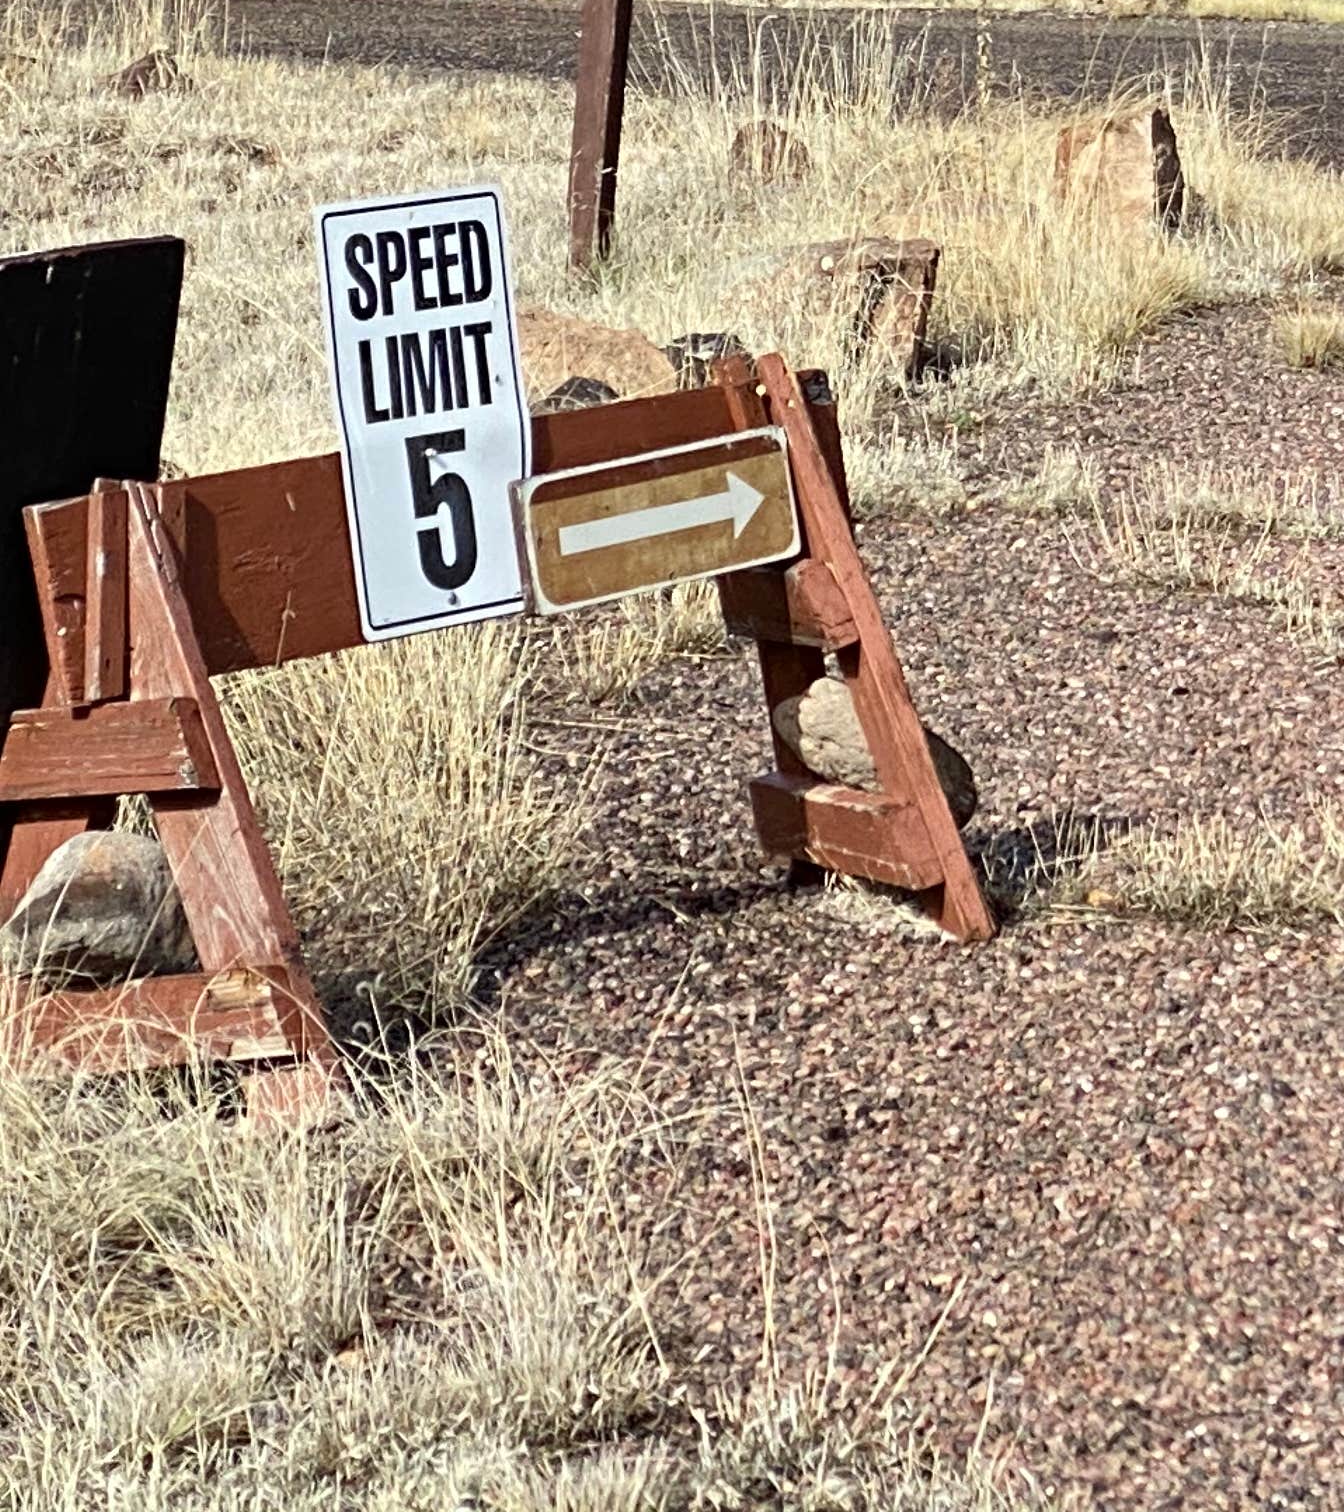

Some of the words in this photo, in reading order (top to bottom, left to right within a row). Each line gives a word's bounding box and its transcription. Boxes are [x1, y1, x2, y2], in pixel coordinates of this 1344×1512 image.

[345, 219, 493, 321] SPEED
[358, 321, 493, 424] LIMIT
[404, 428, 478, 591] 5
